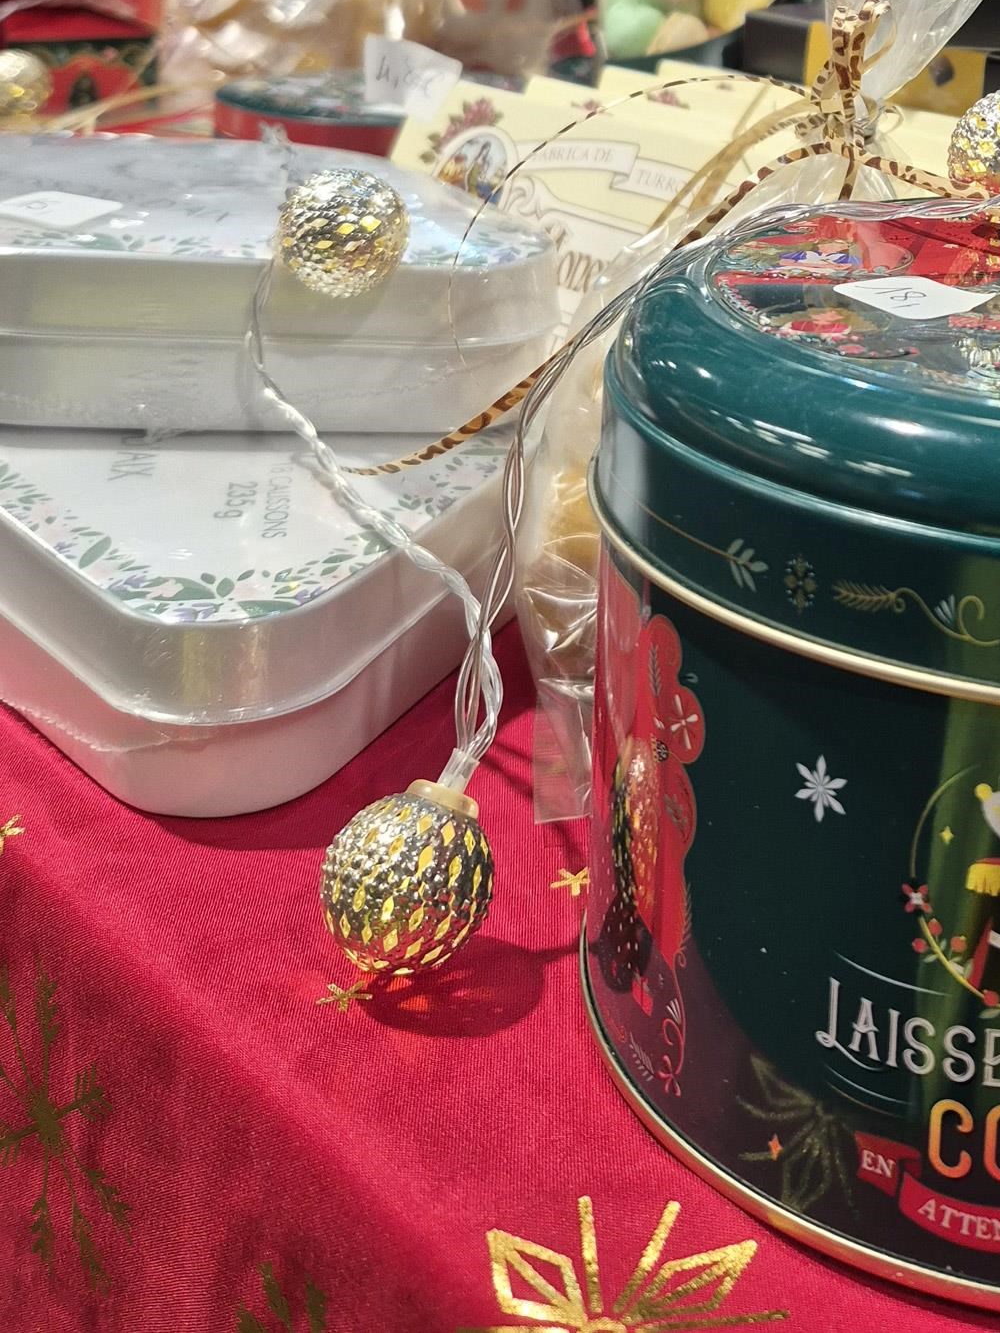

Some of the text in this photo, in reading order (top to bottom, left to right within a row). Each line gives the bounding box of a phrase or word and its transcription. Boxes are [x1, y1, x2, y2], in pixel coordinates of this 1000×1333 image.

[638, 169, 688, 194] TURRO
[261, 476, 293, 539] CALISSONS
[861, 1150, 897, 1178] EN
